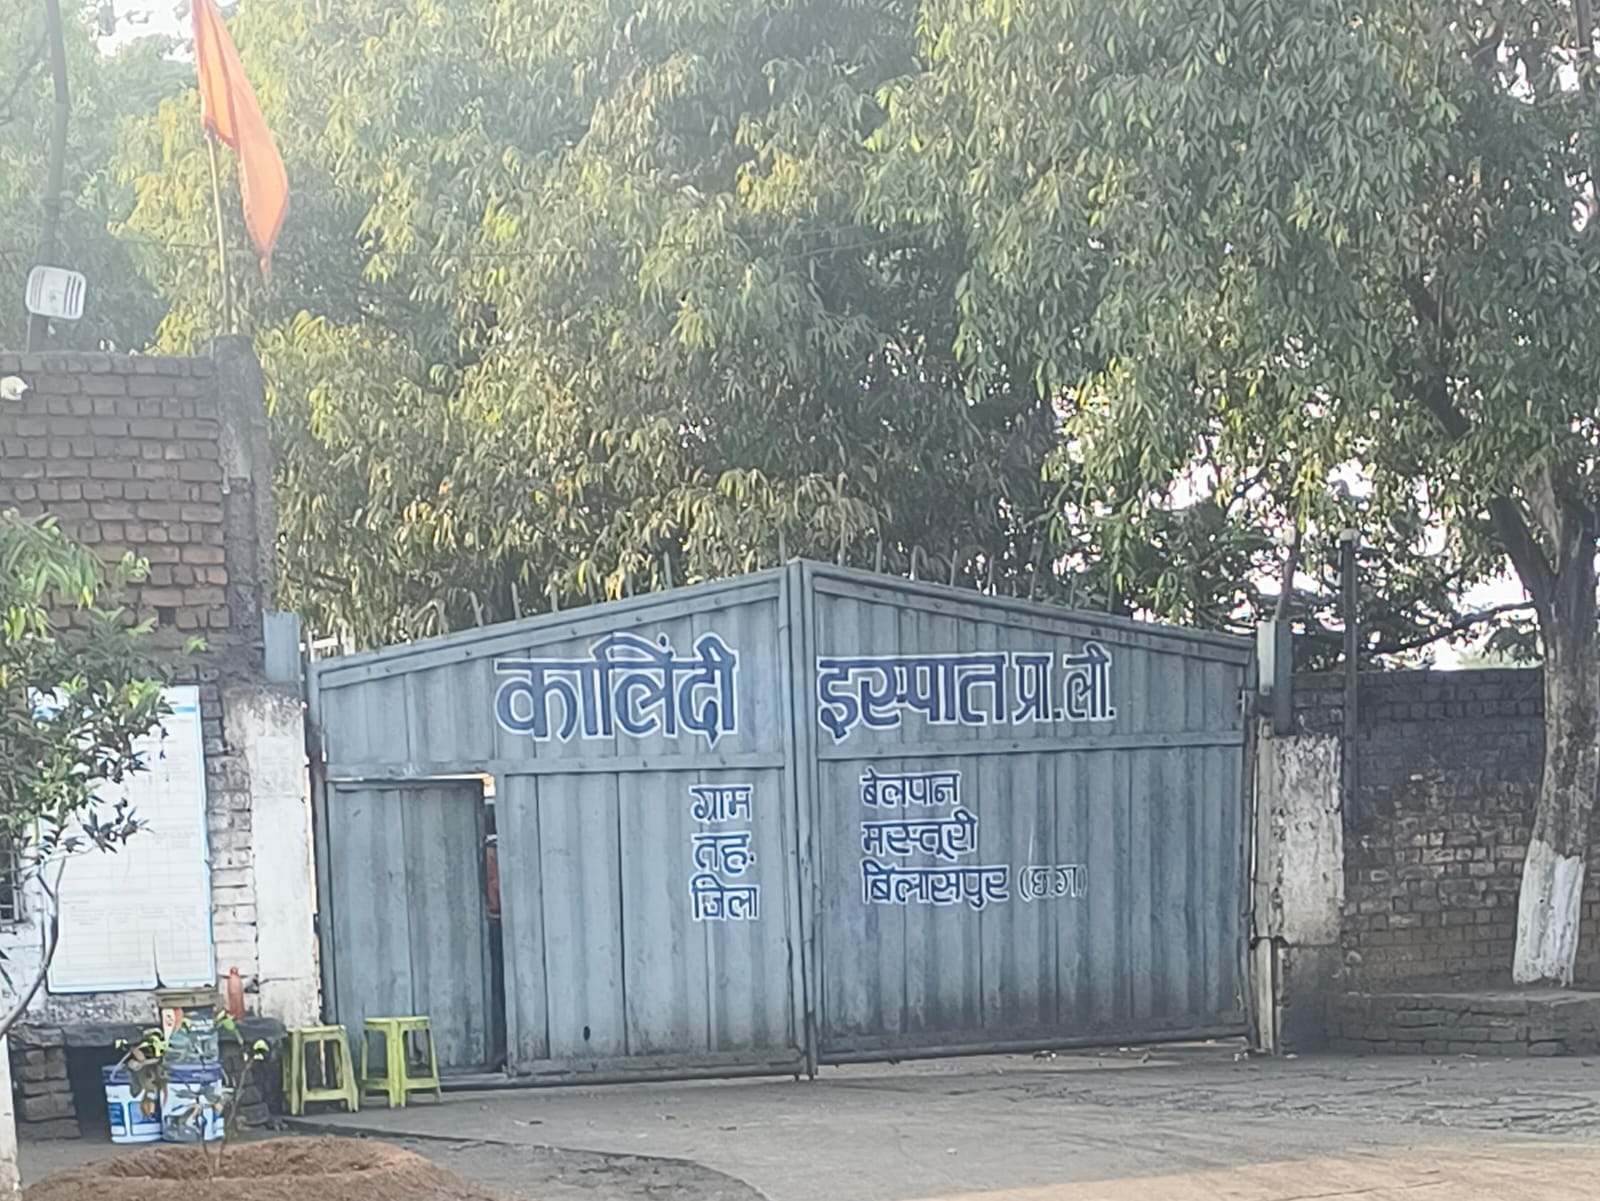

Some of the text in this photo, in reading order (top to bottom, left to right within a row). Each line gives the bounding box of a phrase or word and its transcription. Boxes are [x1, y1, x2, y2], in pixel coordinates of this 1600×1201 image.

[495, 632, 739, 748] कालिंदी
[816, 652, 1008, 743] इस्पात
[688, 766, 962, 823] ग्राम बेलपान
[689, 873, 760, 920] जिला
[861, 858, 1009, 910] बिलासपुर
